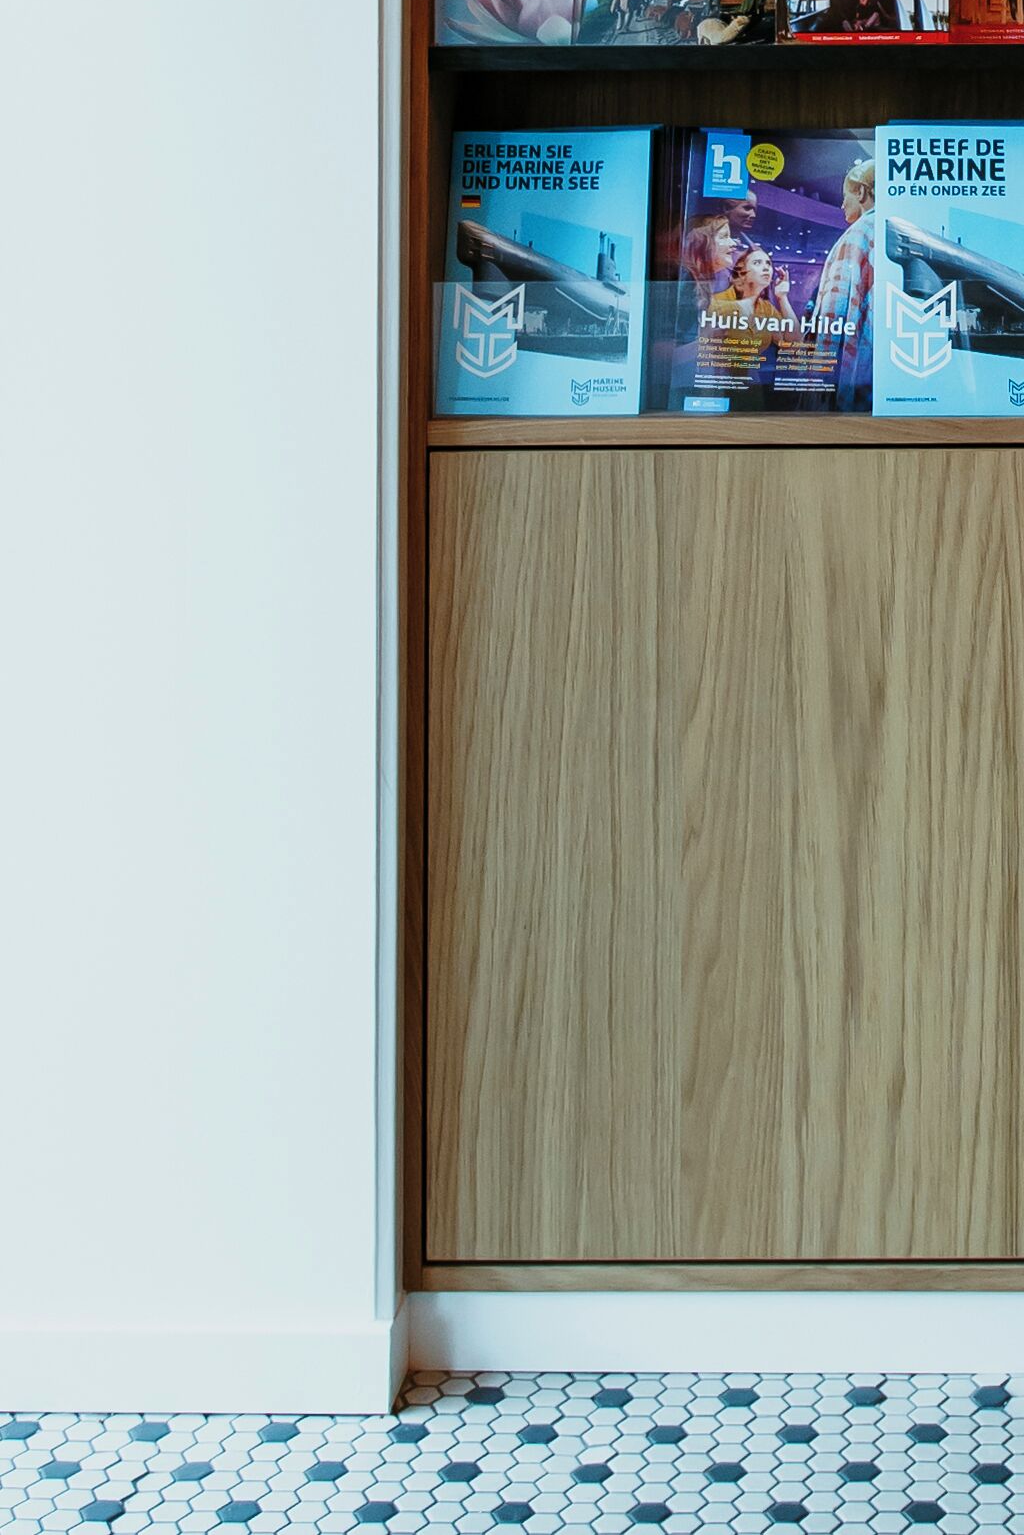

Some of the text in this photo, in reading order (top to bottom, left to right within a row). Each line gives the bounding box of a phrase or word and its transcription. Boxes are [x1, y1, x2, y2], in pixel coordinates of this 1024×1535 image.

[463, 145, 572, 159] ERLEBEN SIE
[888, 139, 1005, 156] BELEEF DE
[463, 161, 604, 174] DIE MARINE AUF
[888, 158, 1006, 181] MARINE
[462, 176, 600, 190] UND UNTER SEE
[888, 183, 1006, 196] OP ÉN ONDER ZEE
[700, 310, 857, 336] Huis van Hilde
